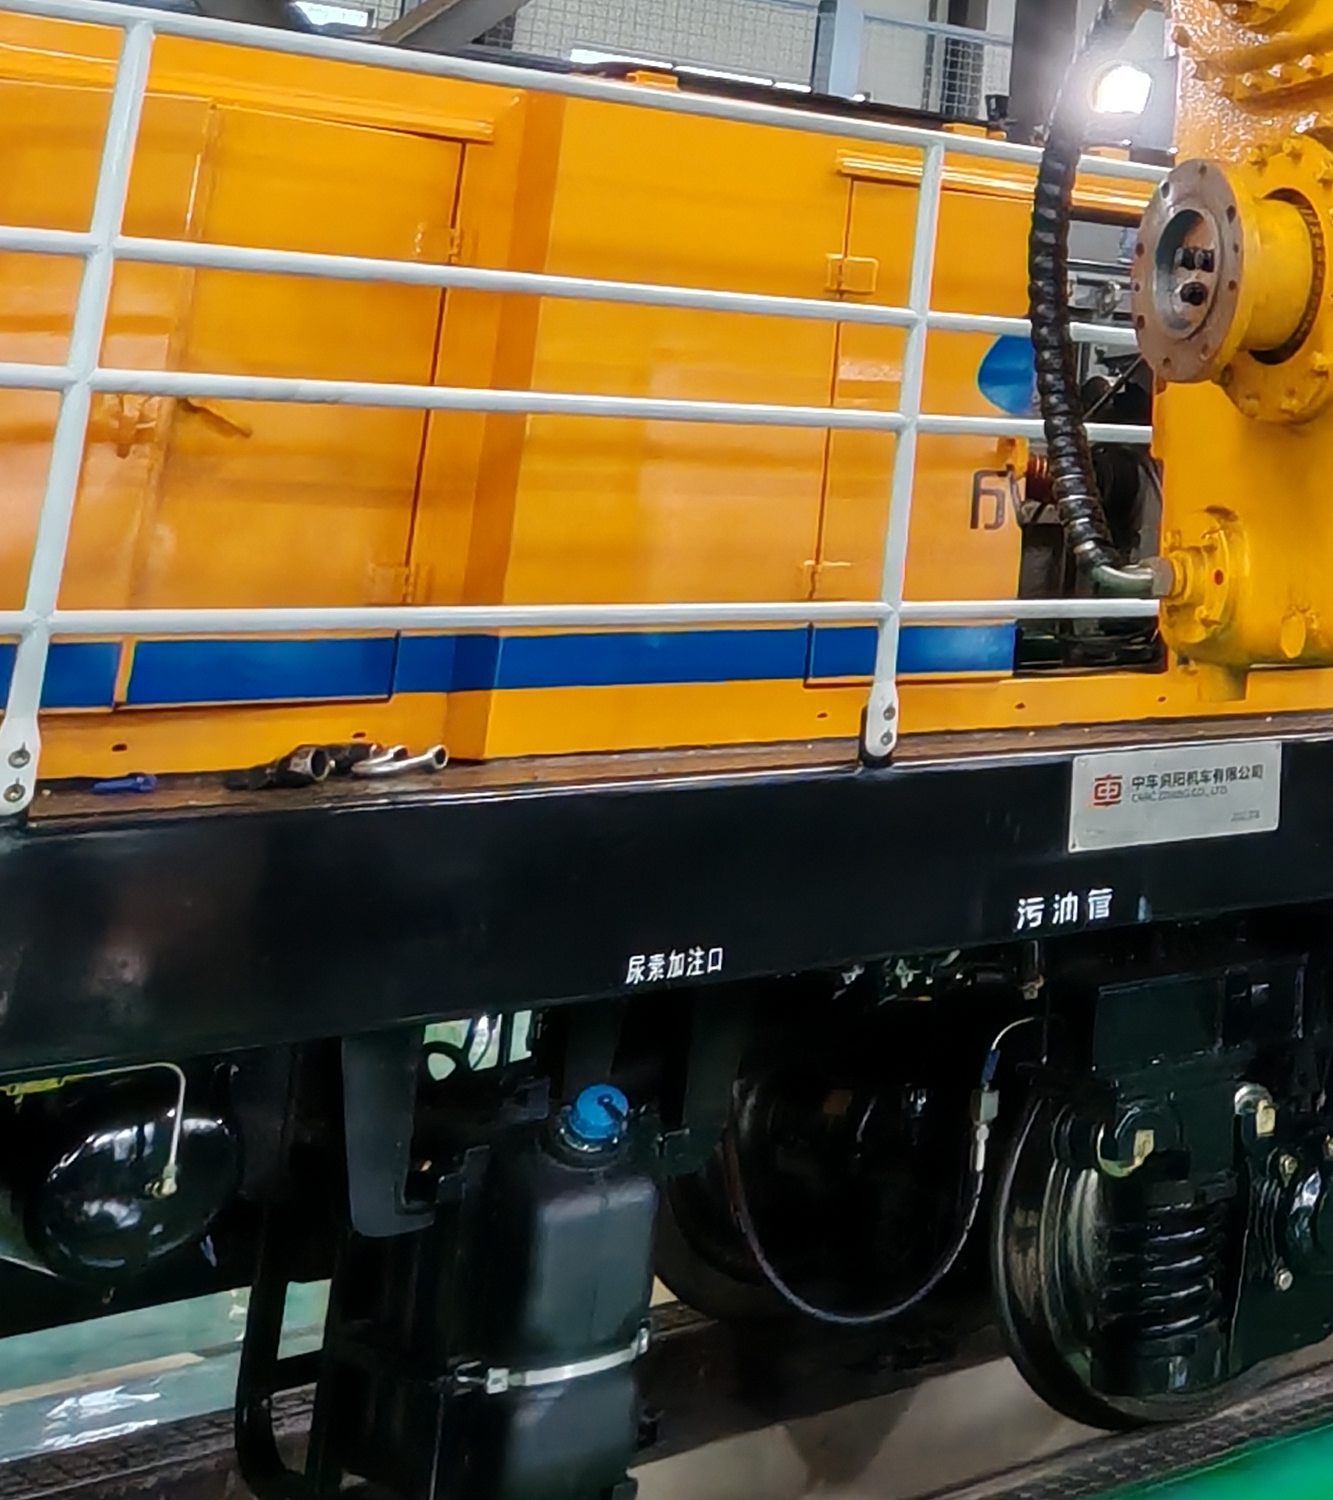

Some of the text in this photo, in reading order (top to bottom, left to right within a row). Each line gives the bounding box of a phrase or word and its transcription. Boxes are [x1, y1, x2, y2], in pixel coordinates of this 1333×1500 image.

[1016, 888, 1114, 930] 污油管
[625, 946, 724, 985] 尿素加注口
